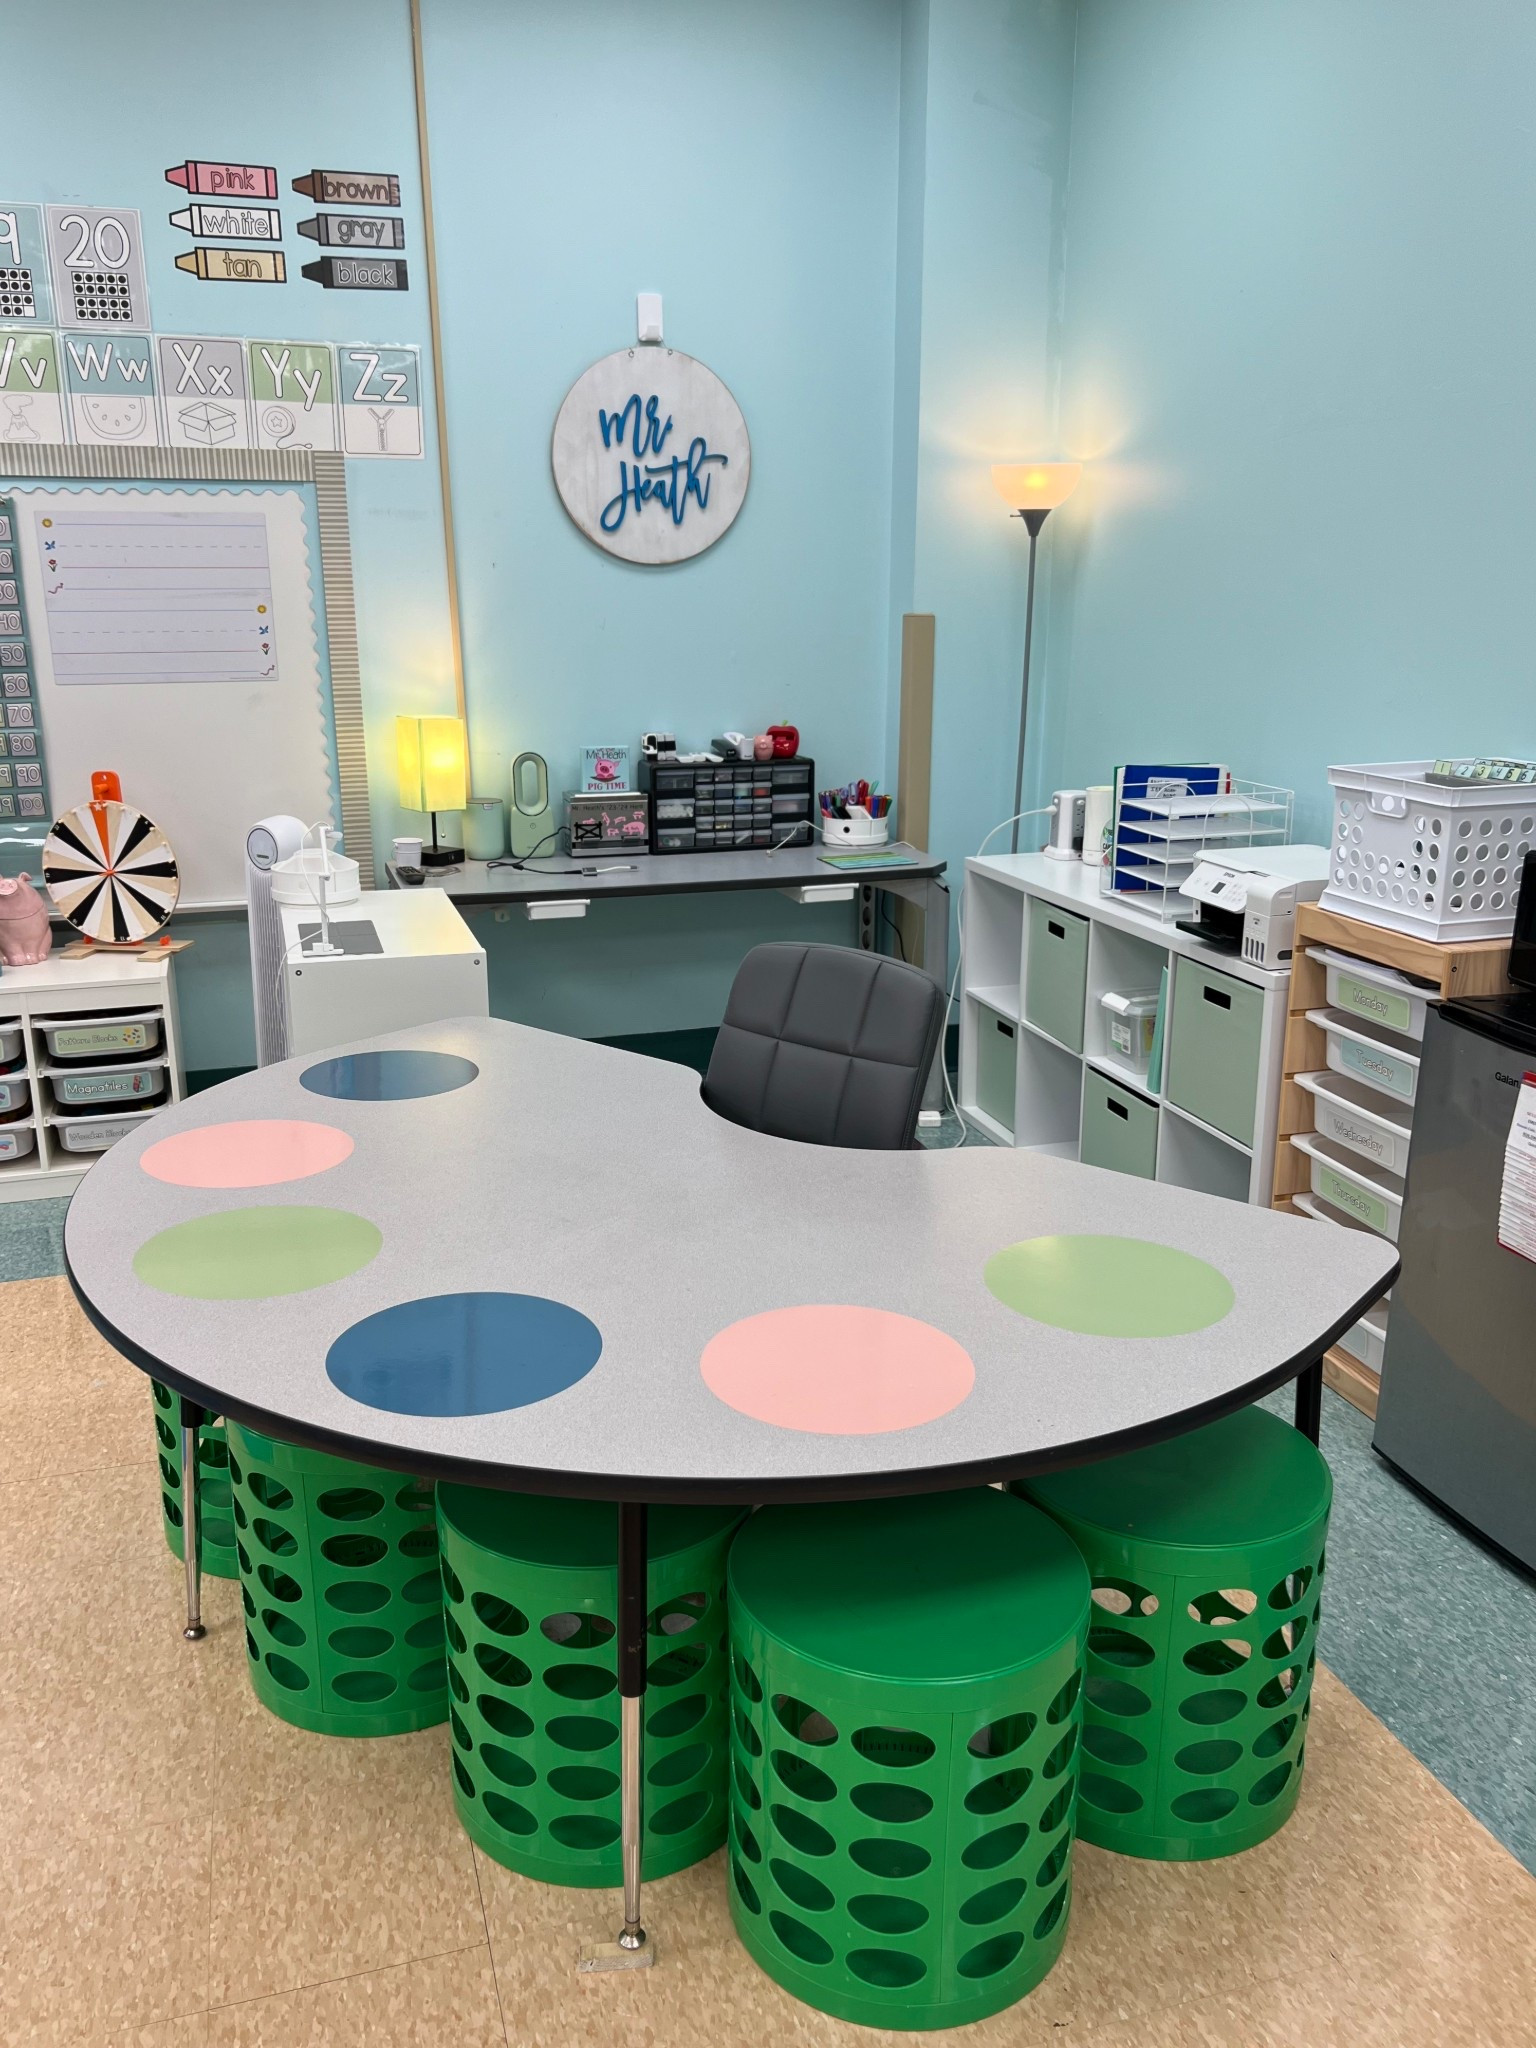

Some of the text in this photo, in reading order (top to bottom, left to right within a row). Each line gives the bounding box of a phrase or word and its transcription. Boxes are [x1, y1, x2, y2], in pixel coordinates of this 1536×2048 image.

[210, 167, 255, 192] pink
[323, 175, 388, 200] brown
[203, 210, 270, 235] white
[60, 214, 131, 269] 20
[337, 219, 386, 246] gray
[222, 251, 262, 278] tan
[337, 261, 394, 286] black
[66, 341, 148, 383] Ww
[172, 342, 234, 396] Xx
[260, 347, 322, 412] Yy
[349, 352, 409, 402] Zz
[599, 393, 673, 458] Mr.
[600, 437, 728, 532] Heath
[1, 645, 24, 662] 50
[5, 676, 28, 693] 60
[7, 706, 32, 723] 70
[11, 735, 34, 752] 80
[602, 749, 627, 760] Heath
[17, 766, 41, 783] 90
[1440, 763, 1445, 773] 1
[1461, 767, 1468, 776] 2
[1478, 766, 1486, 776] 3
[1496, 768, 1503, 777] 4
[1506, 768, 1515, 779] 5
[1521, 770, 1529, 781] 6
[605, 782, 627, 790] TIME
[20, 796, 43, 811] 100
[1352, 988, 1388, 1016] Monday
[58, 1034, 118, 1047] Pattern Blocks
[1356, 1048, 1394, 1081] Tuesday
[67, 1080, 128, 1095] Magnatiles
[1494, 1071, 1521, 1089] Galan
[68, 1131, 105, 1142] Wooden
[1333, 1119, 1383, 1156] Wednesday
[1331, 1179, 1371, 1216] Thursday
